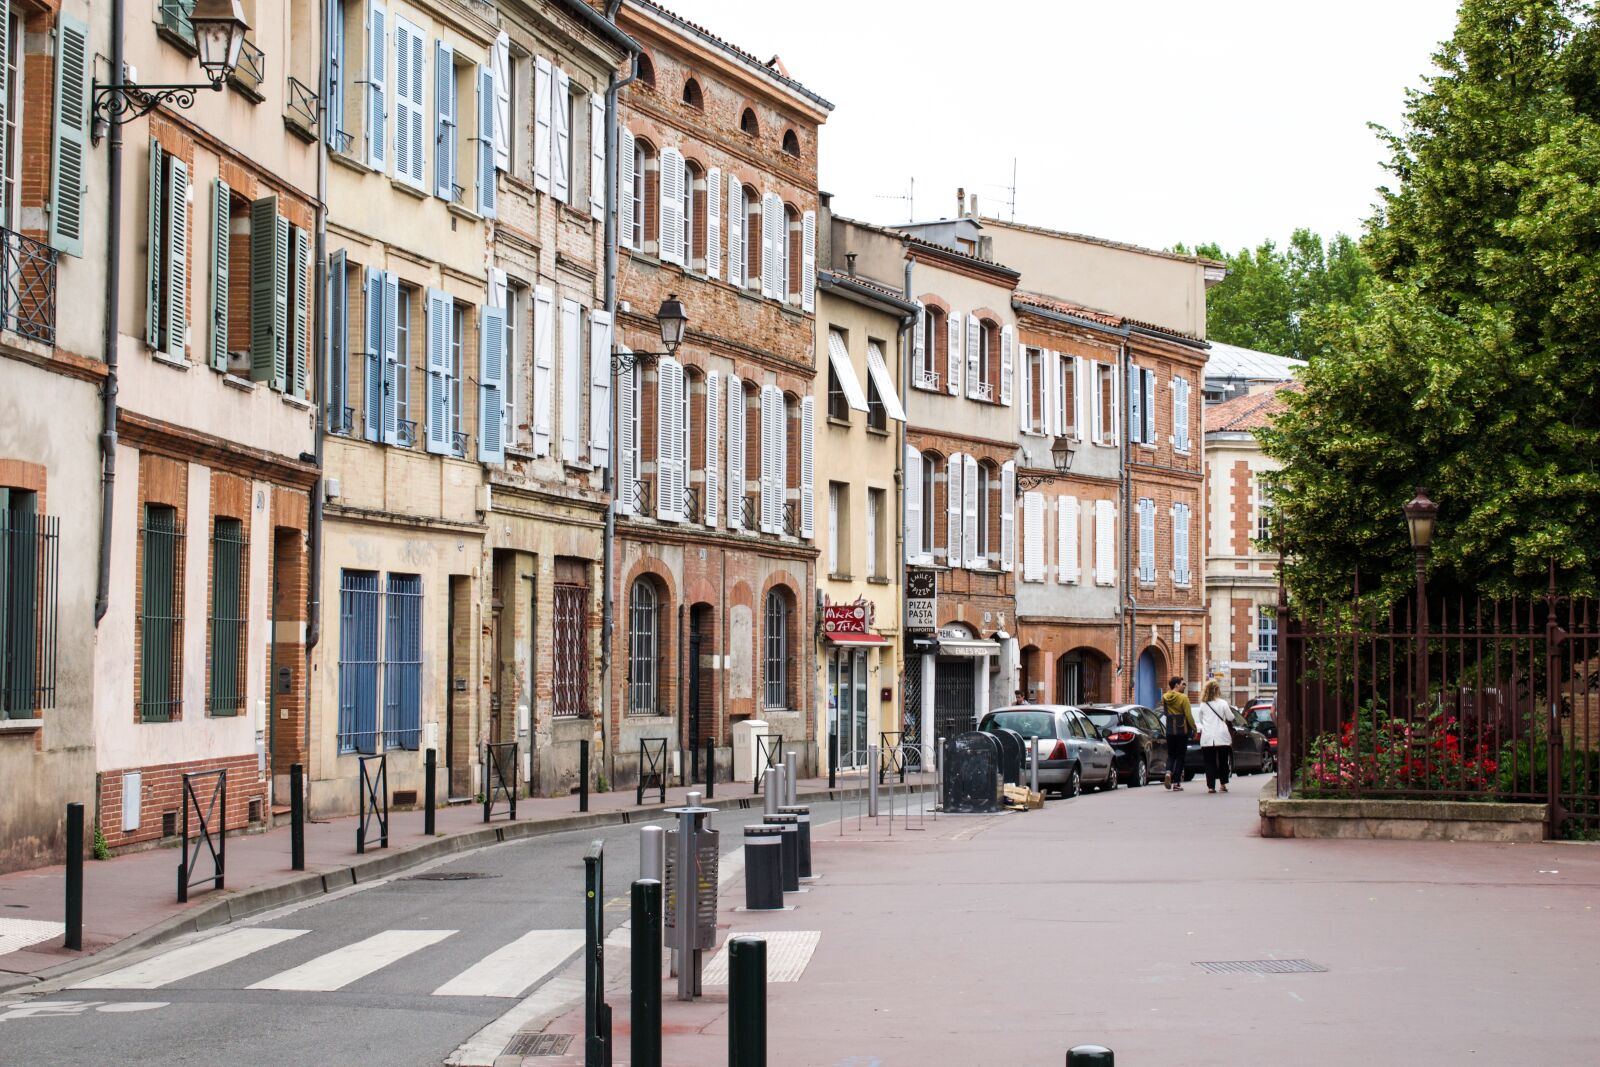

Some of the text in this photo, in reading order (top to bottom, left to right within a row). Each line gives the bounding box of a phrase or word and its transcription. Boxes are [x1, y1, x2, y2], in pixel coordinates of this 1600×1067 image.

[912, 586, 931, 596] PIZZA
[909, 601, 932, 609] PIZZA
[909, 610, 932, 618] PASTA
